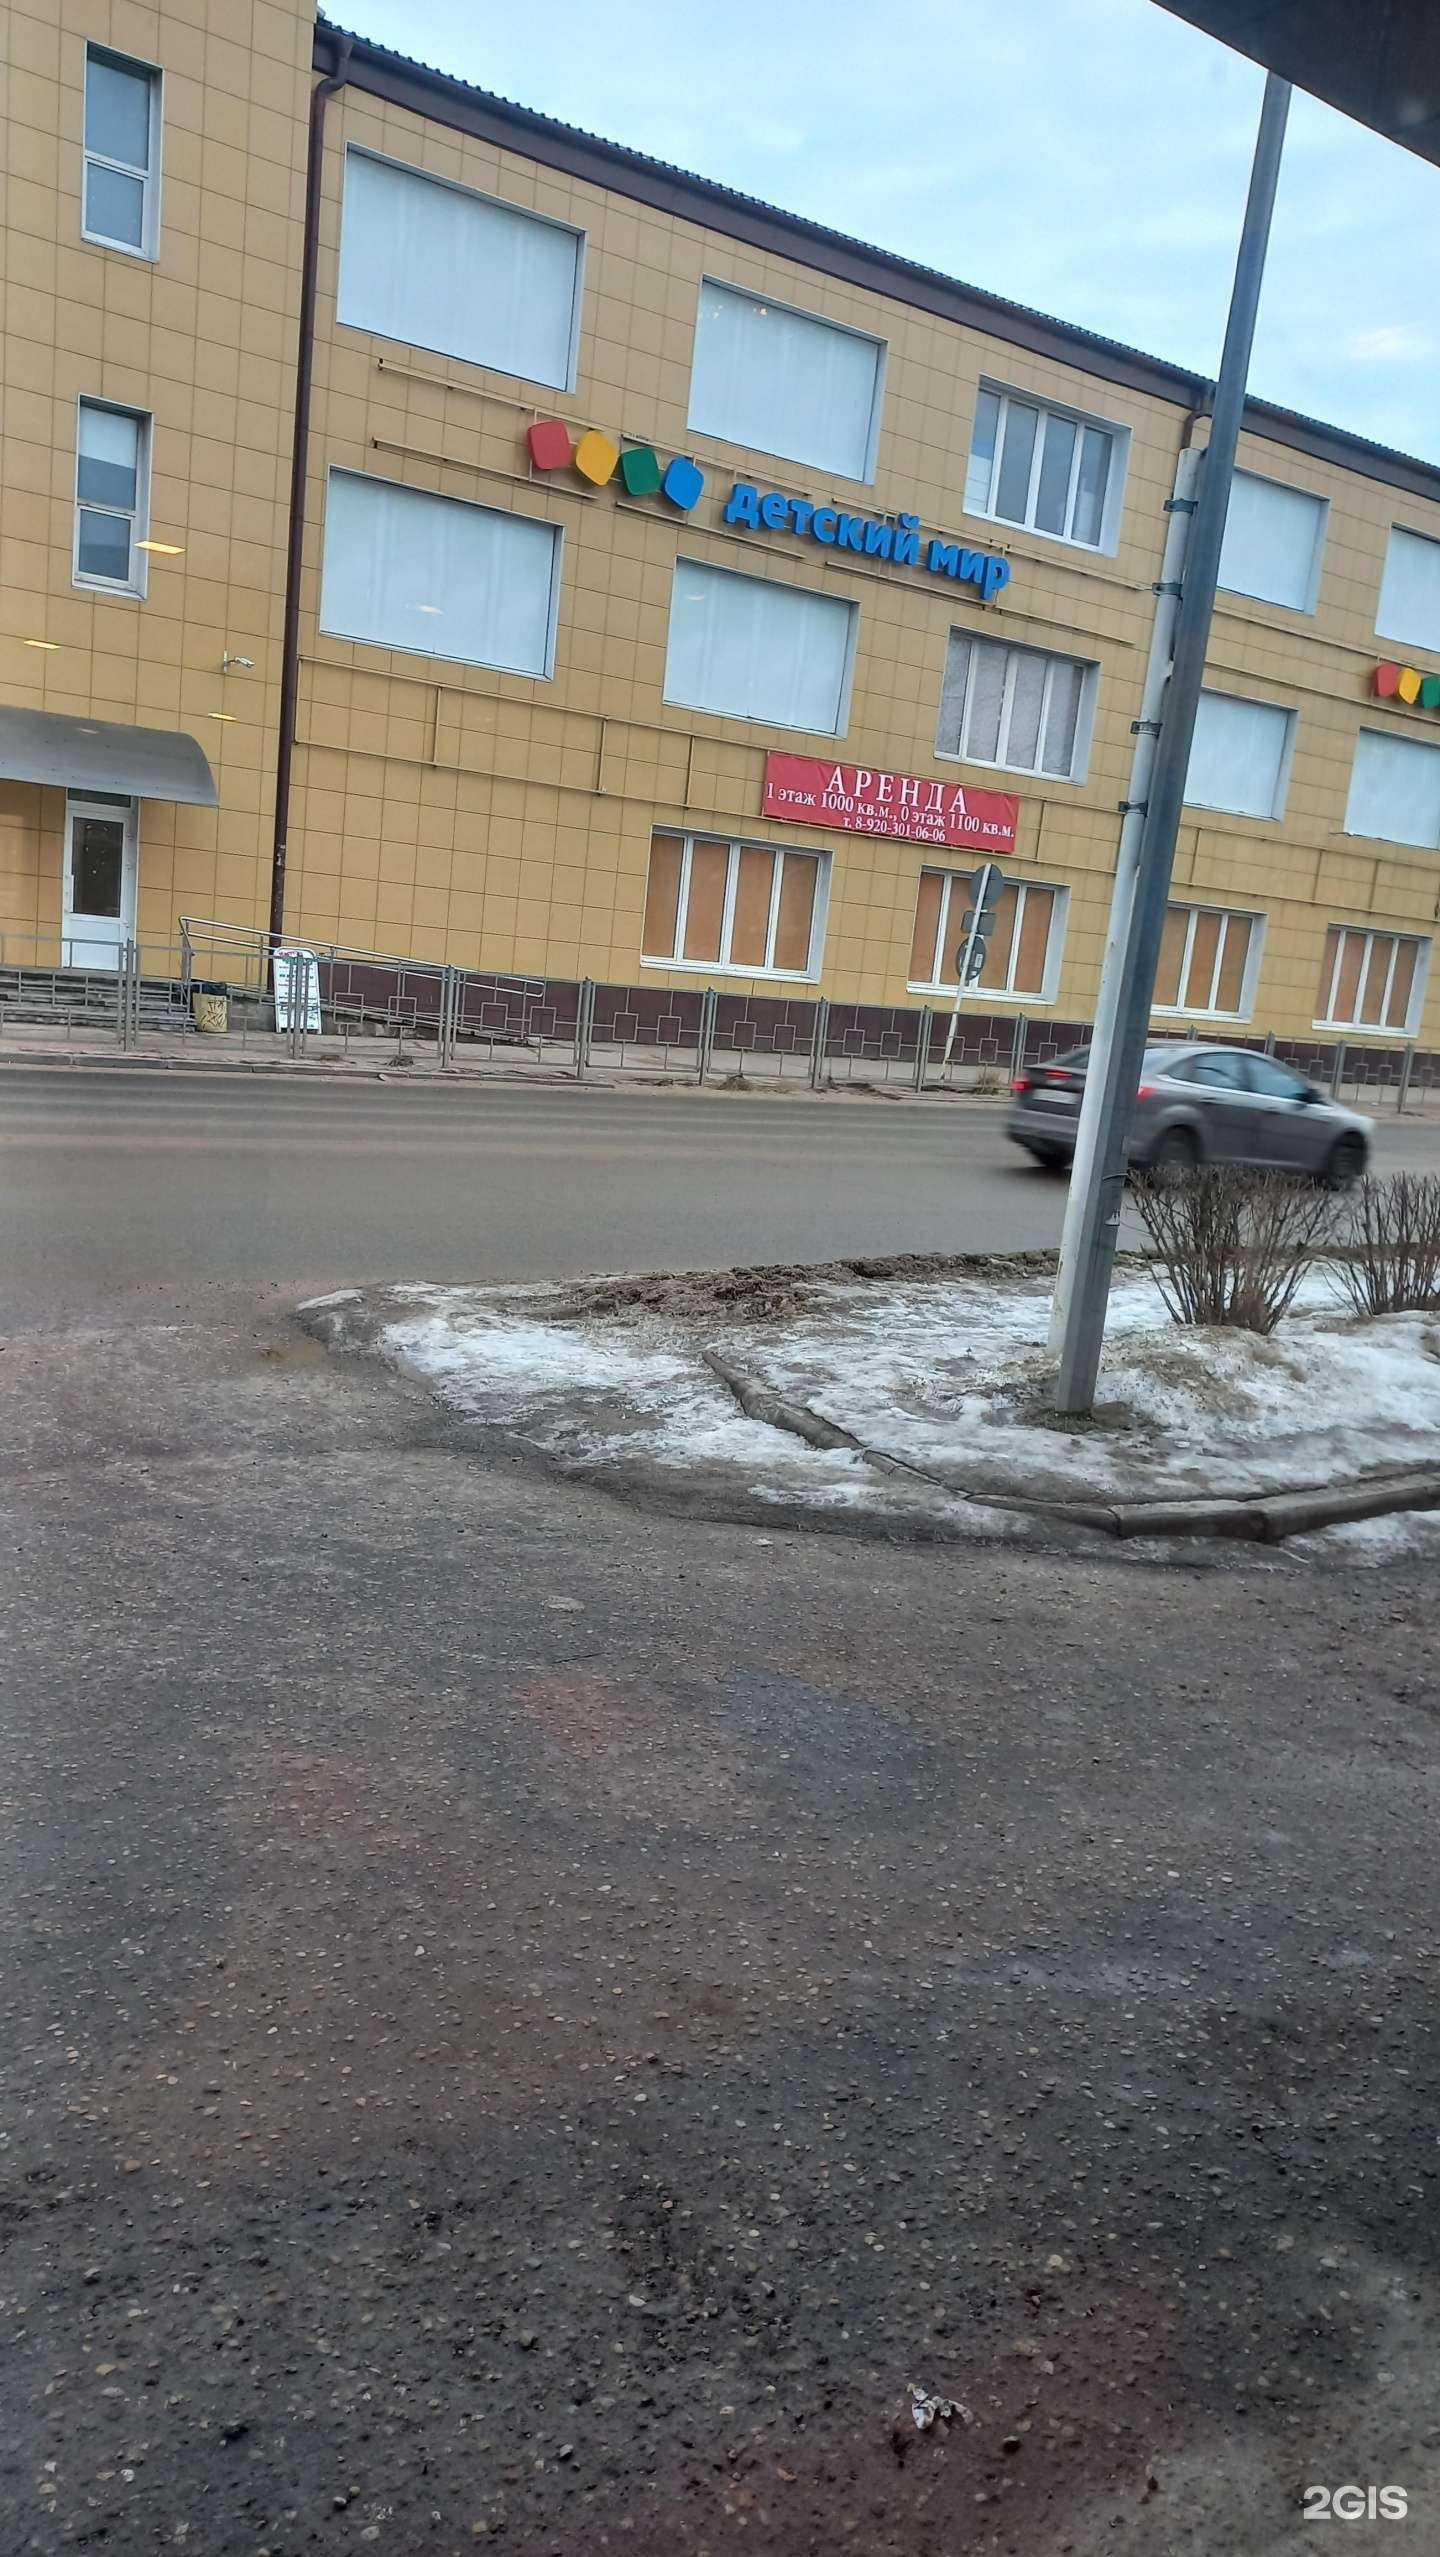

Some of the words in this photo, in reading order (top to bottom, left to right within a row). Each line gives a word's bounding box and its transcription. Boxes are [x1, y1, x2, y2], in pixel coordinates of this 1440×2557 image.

[927, 538, 1011, 601] мир
[767, 782, 773, 799] 1
[778, 787, 816, 806] этаж
[821, 793, 854, 812] 1000
[901, 806, 909, 821] 0
[912, 811, 945, 827] этаж
[950, 814, 980, 832] 1100
[982, 822, 1015, 838] кв.м.
[825, 766, 968, 815] АРЕНДА
[855, 816, 946, 842] 8-920-301-06-06
